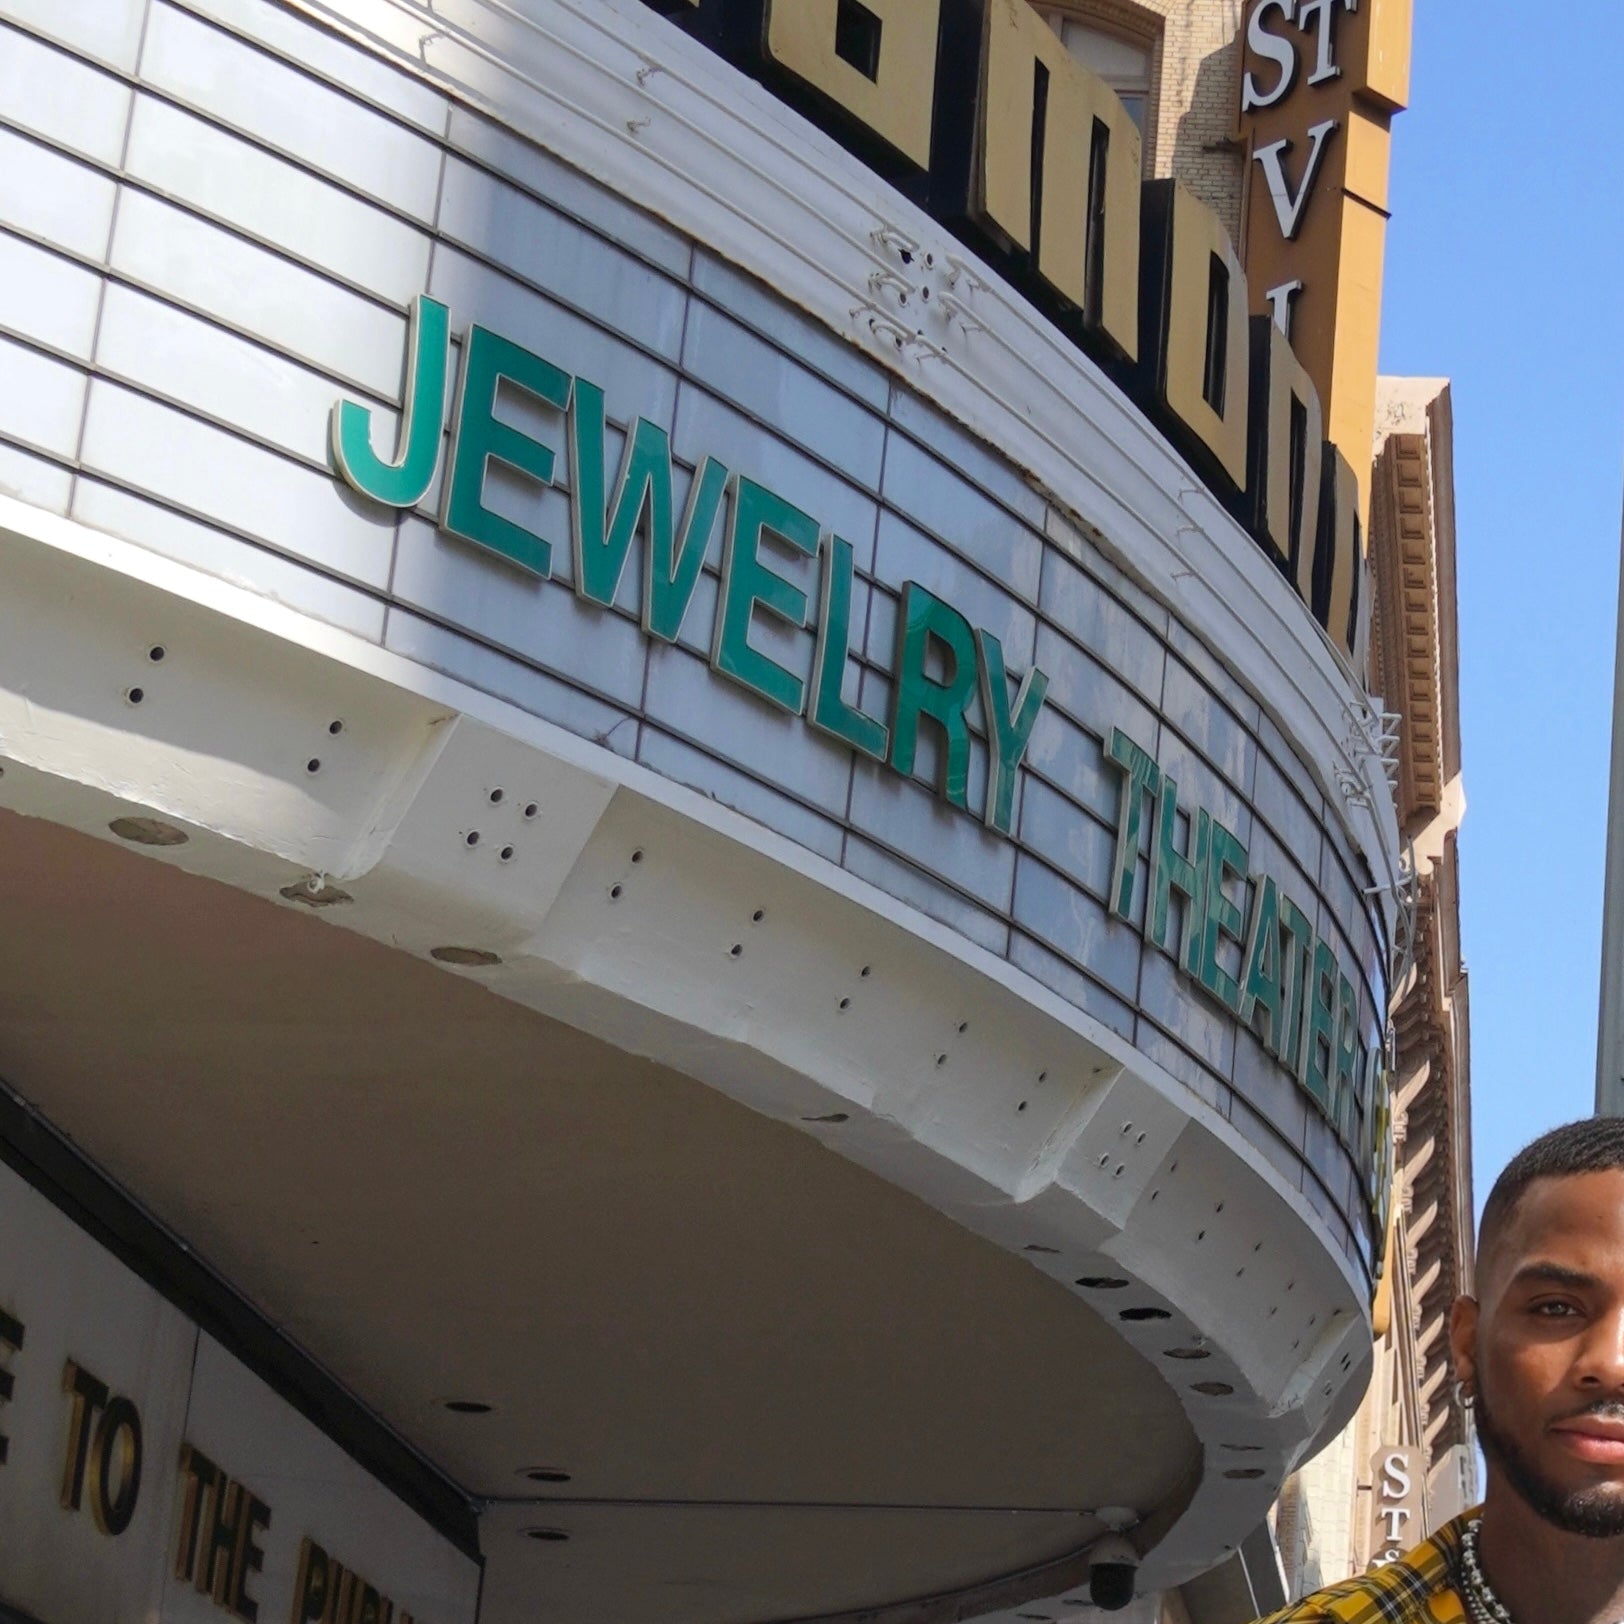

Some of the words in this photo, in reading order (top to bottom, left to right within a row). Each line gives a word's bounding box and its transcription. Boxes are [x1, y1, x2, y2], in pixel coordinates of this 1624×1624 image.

[330, 293, 1051, 838] JEWELRY
[1104, 725, 1358, 1145] THEATER
[60, 1356, 143, 1536] TO
